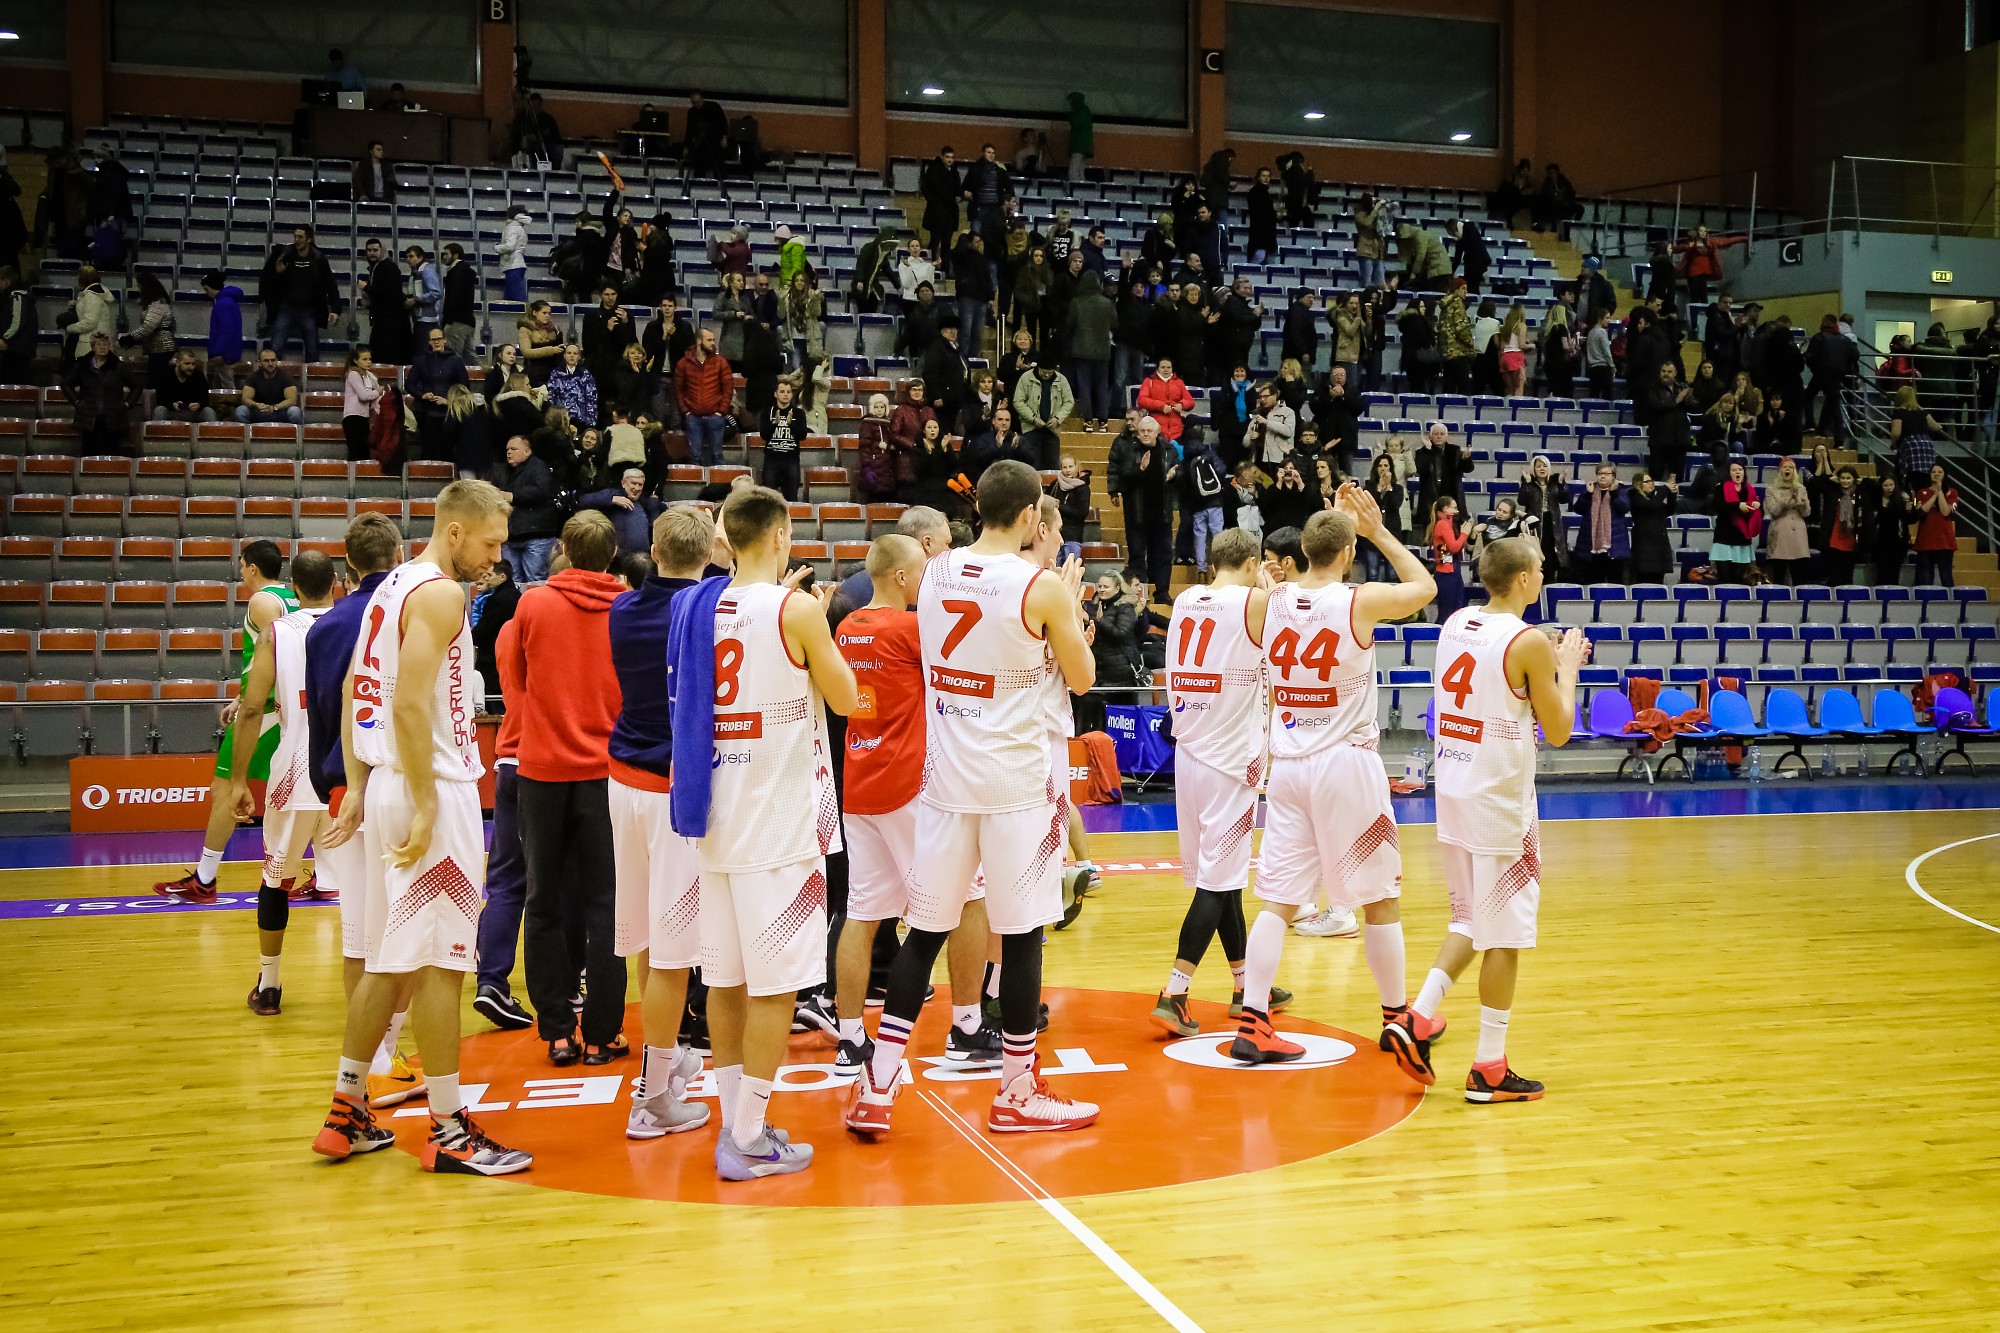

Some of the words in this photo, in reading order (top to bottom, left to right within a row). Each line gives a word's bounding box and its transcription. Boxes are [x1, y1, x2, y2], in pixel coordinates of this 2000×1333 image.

[491, 0, 505, 20] B
[1205, 52, 1219, 71] C
[934, 580, 1001, 597] www.liepaja.lv
[940, 599, 983, 661] 7
[847, 636, 875, 645] TRIOBET
[1177, 616, 1217, 667] 11
[1268, 626, 1341, 682] 44
[713, 638, 745, 706] 8
[1441, 651, 1477, 710] 4
[941, 674, 987, 690] TRIOBET
[1180, 677, 1218, 687] TRIOBET
[448, 645, 469, 747] SPORTLAND
[1289, 693, 1331, 702] TRIOBET
[944, 704, 982, 719] pepsi
[1107, 715, 1136, 731] molten
[1296, 714, 1331, 728] pepsi
[1440, 719, 1480, 736] TRIOBET
[721, 749, 751, 769] pepsi
[116, 786, 211, 804] TRIOBET
